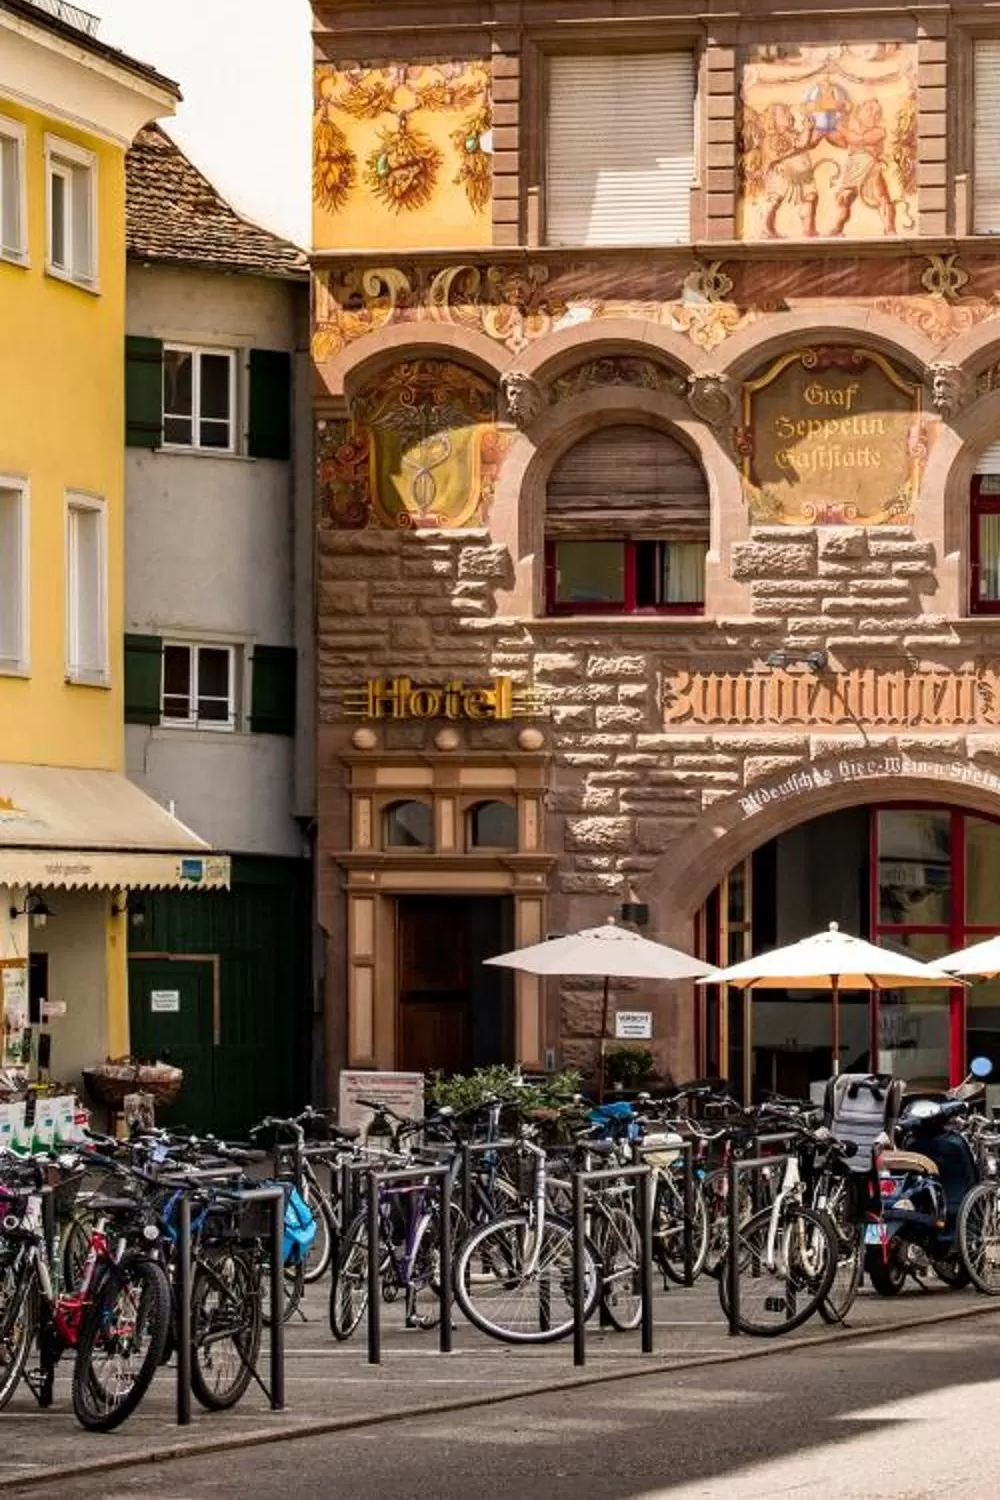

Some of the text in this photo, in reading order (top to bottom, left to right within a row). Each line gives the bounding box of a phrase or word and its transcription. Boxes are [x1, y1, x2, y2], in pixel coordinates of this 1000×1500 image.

[804, 383, 860, 410] Graf
[774, 416, 885, 440] Zeppelin
[367, 675, 513, 719] Hotel
